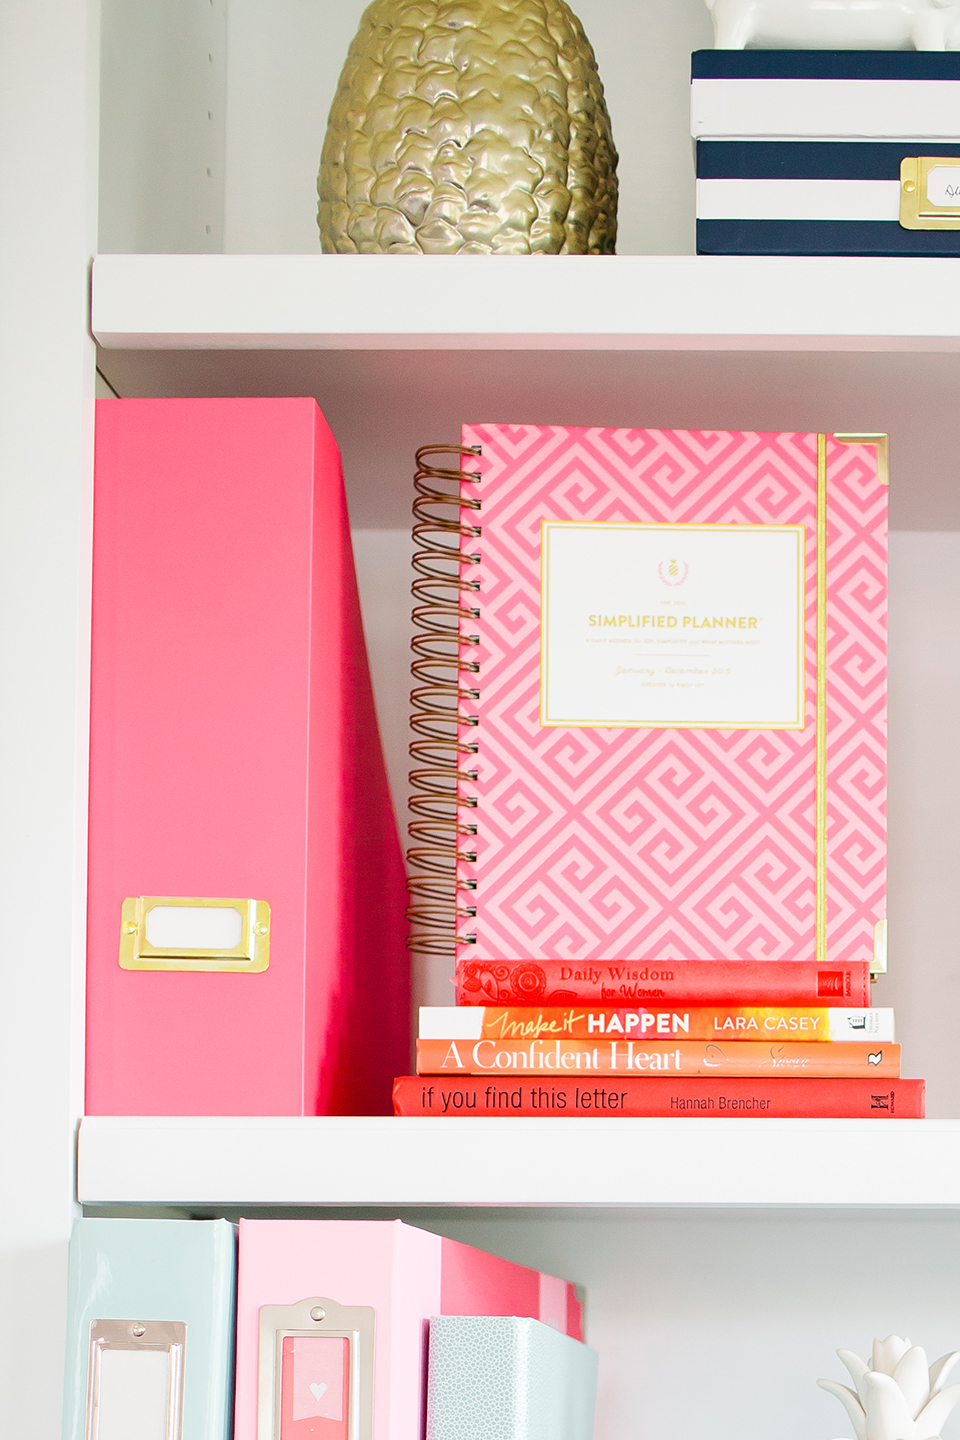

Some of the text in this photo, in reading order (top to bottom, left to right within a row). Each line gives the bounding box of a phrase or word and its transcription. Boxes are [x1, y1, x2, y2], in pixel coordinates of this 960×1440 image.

[588, 615, 678, 628] SIMPLIFIED
[615, 666, 656, 676] January
[665, 666, 709, 675] December
[560, 967, 674, 985] Daily Wisdom
[601, 982, 666, 1001] for Women
[587, 1013, 690, 1033] HAPPEN
[714, 1017, 759, 1030] LARA
[764, 1017, 820, 1030] CASEY
[440, 1039, 683, 1070] A Confident Heart
[421, 1086, 771, 1113] if you find this letter Hannah Brencher
